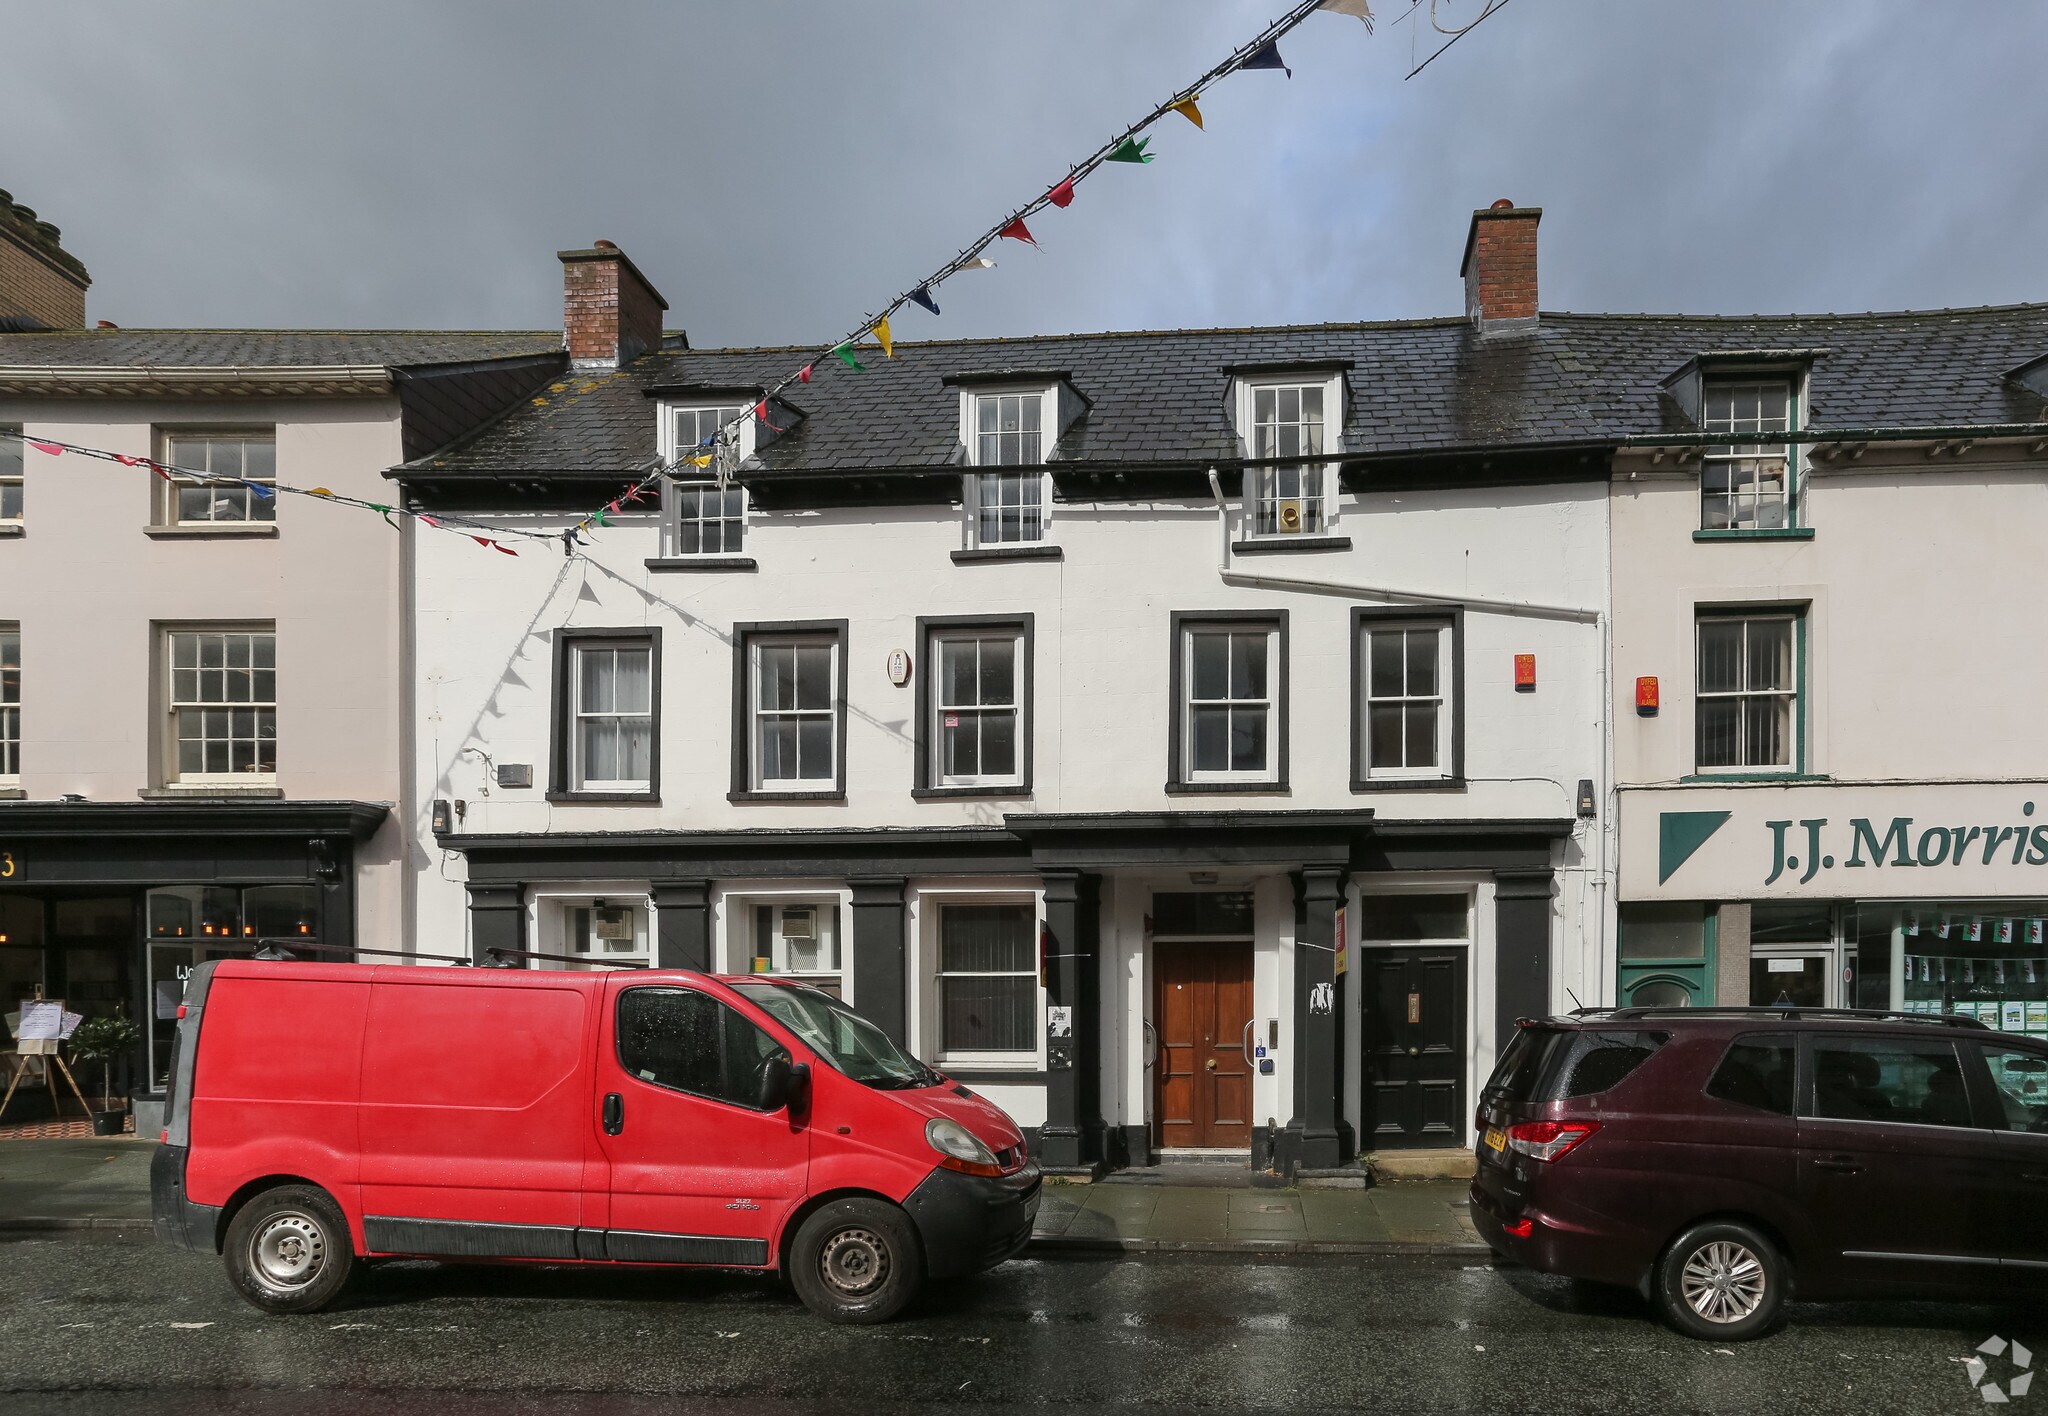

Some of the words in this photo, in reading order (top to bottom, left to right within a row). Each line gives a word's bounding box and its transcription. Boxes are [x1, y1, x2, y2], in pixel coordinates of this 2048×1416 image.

[1640, 677, 1657, 685] DYFED
[1765, 818, 1835, 886] J.J.
[1844, 801, 2048, 868] Morris
